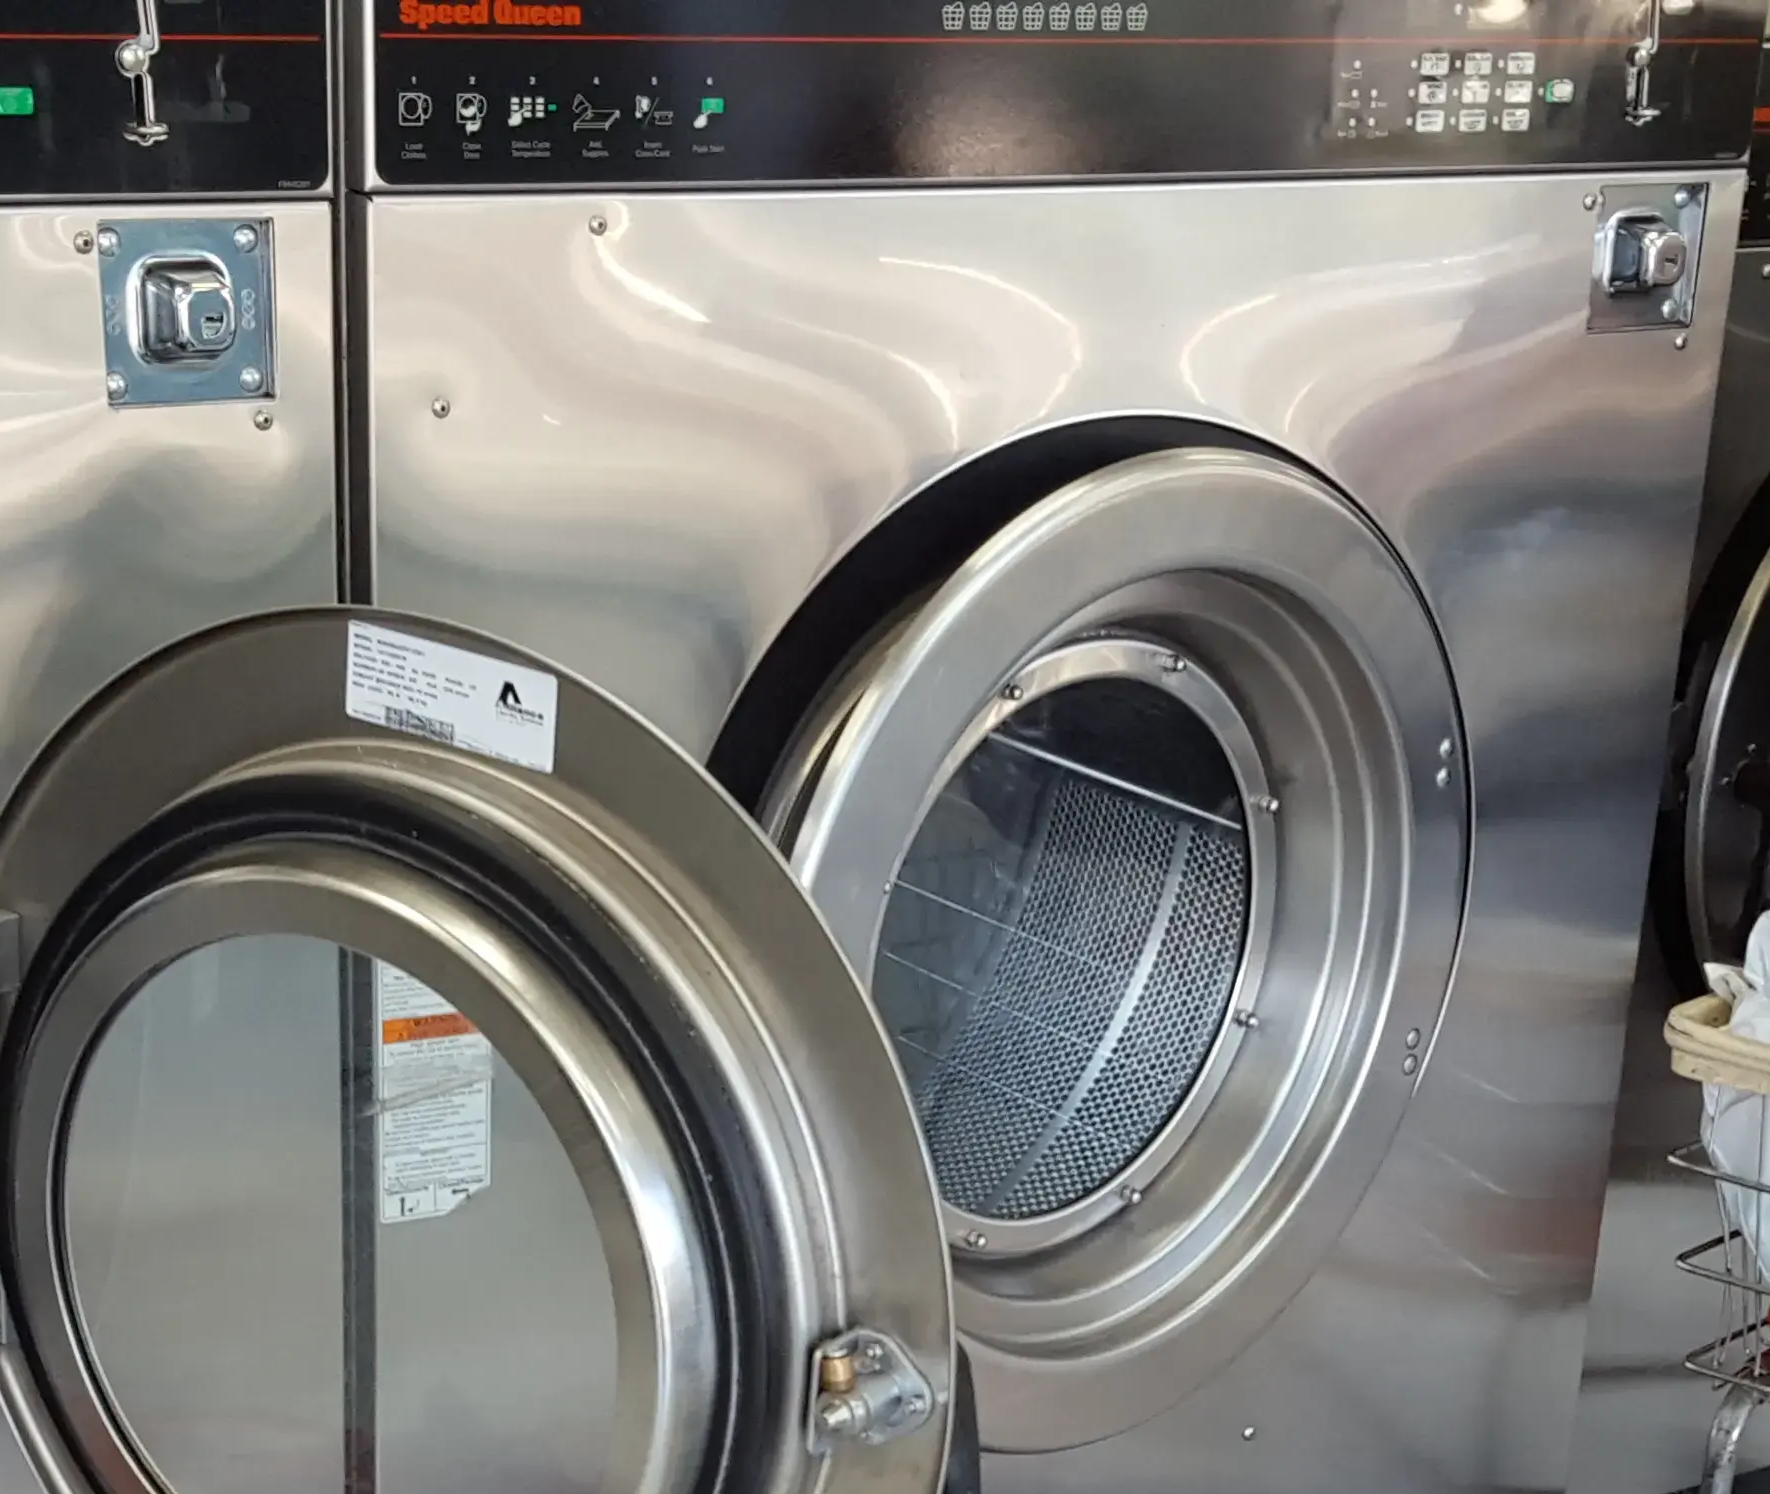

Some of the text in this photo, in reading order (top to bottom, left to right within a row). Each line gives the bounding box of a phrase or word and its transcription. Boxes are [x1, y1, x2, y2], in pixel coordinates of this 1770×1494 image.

[399, 0, 581, 30] Speed Queen
[411, 75, 417, 85] 1
[469, 75, 476, 85] 2
[529, 75, 536, 85] 3
